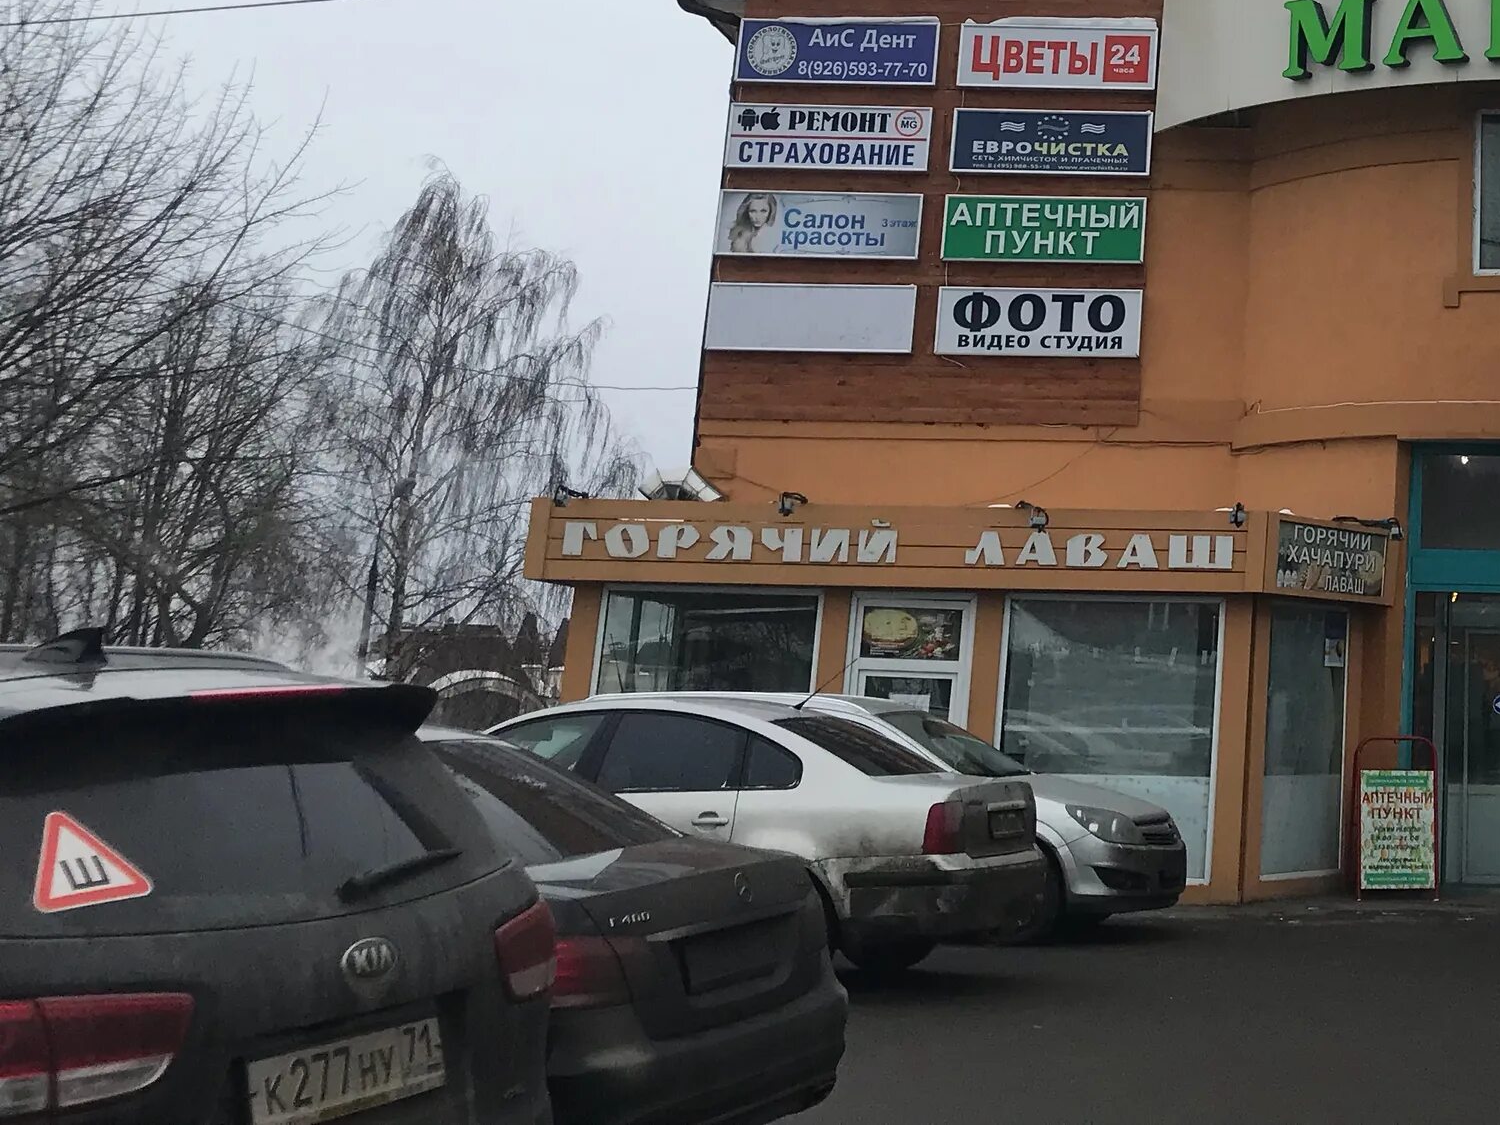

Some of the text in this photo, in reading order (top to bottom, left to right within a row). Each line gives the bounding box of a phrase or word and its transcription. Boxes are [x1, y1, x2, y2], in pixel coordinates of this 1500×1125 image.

[808, 29, 917, 52] АиС Дент
[972, 35, 1098, 81] ЦВЕТЫ
[1110, 45, 1141, 65] 24
[797, 60, 928, 79] 8(926)593-77-70
[788, 110, 891, 133] РЕМОНТ
[900, 120, 918, 129] MG
[738, 141, 915, 166] СТРАХОВАНИЕ
[972, 140, 1129, 156] ЕВРОЧИСТКА
[998, 156, 1057, 164] ХИМЧИСТОК
[784, 208, 865, 229] Салон
[881, 219, 917, 228] 3 этаж
[950, 202, 1140, 229] АПТЕЧНЫЙ
[781, 230, 885, 249] красоты
[985, 230, 1100, 254] ПУНКТ
[953, 292, 1126, 333] ФОТО
[957, 334, 1122, 351] ВИДЕО СТУДИЯ
[562, 519, 1234, 569] ГОРЯЧИЙ ЛАВАШ
[1287, 544, 1376, 573] ХАЧАПУРИ
[1324, 576, 1365, 594] ЛАВАШ
[1371, 808, 1422, 819] ПУНКТ
[61, 856, 109, 889] Ш
[353, 943, 392, 974] KIA
